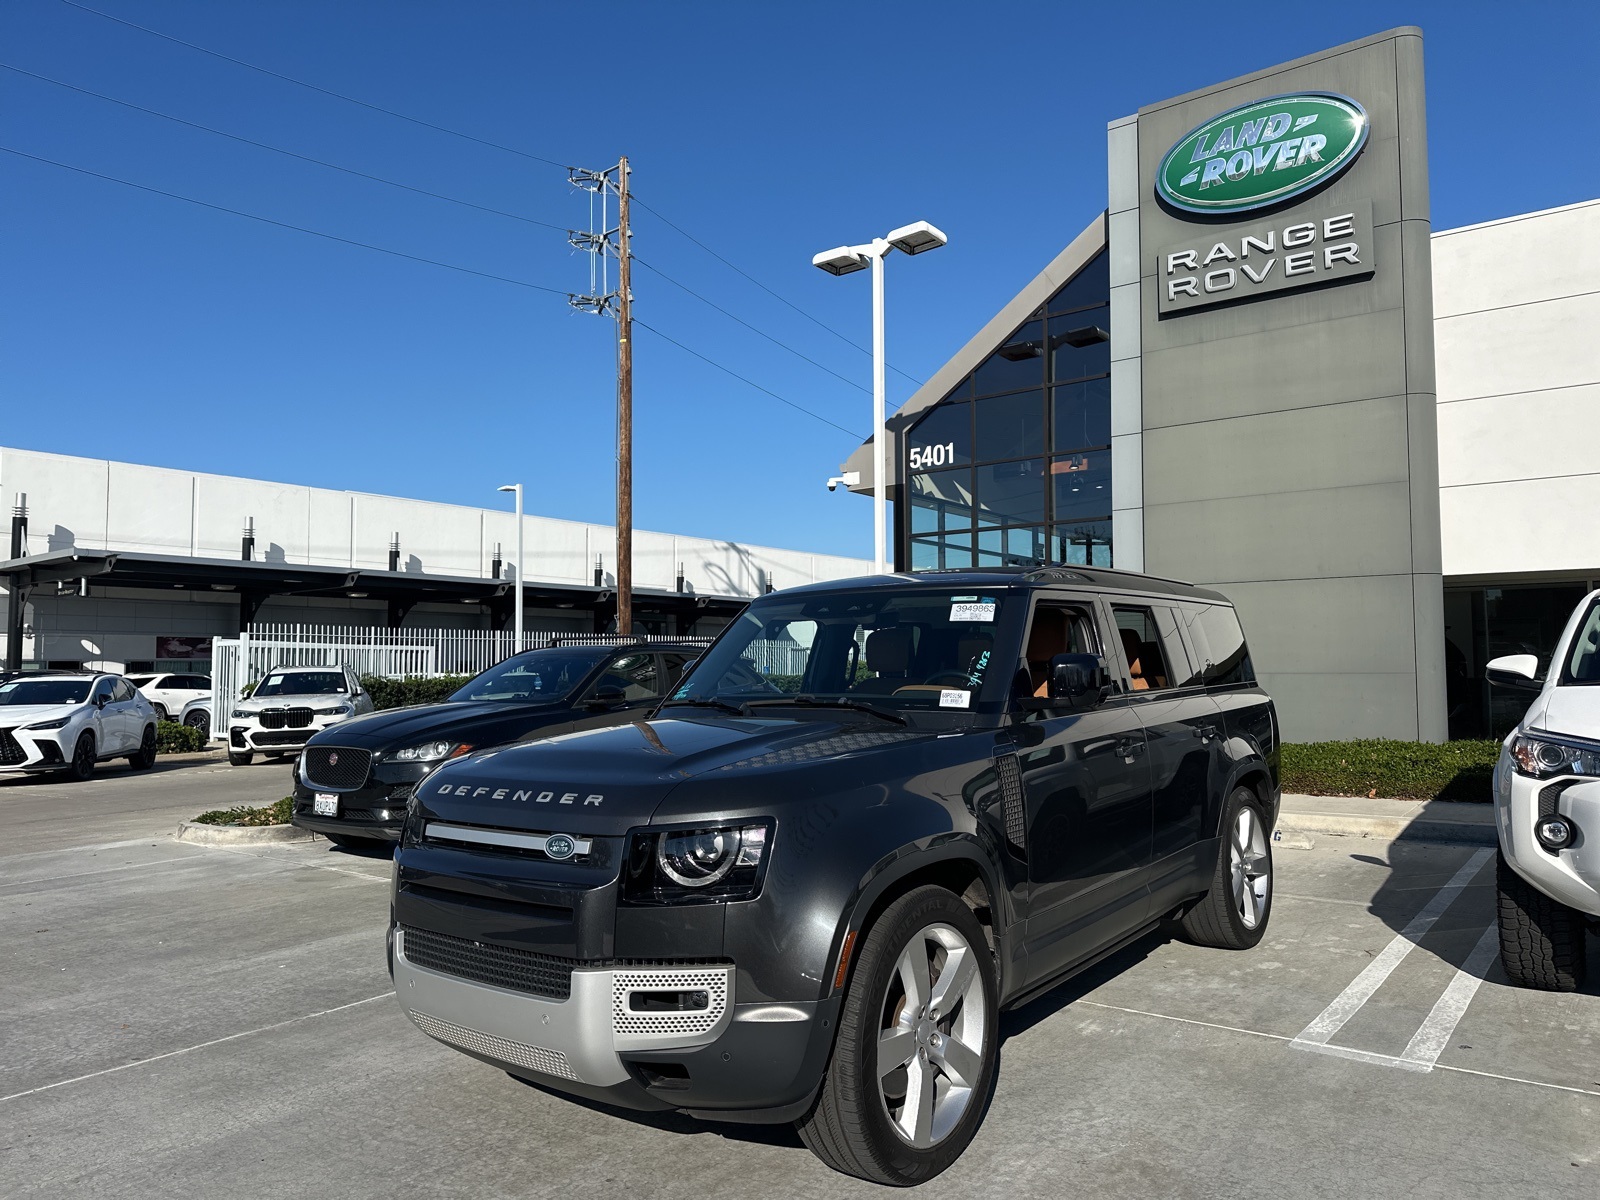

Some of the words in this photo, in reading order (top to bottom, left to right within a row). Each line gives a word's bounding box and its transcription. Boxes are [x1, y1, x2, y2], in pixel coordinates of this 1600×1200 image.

[1189, 112, 1292, 164] LAND
[1198, 133, 1328, 191] ROVER
[1167, 212, 1356, 276] RANGE
[1168, 242, 1362, 301] ROVER
[909, 442, 954, 469] 5401
[955, 604, 995, 613] 3949863
[437, 784, 604, 806] DEFENDER
